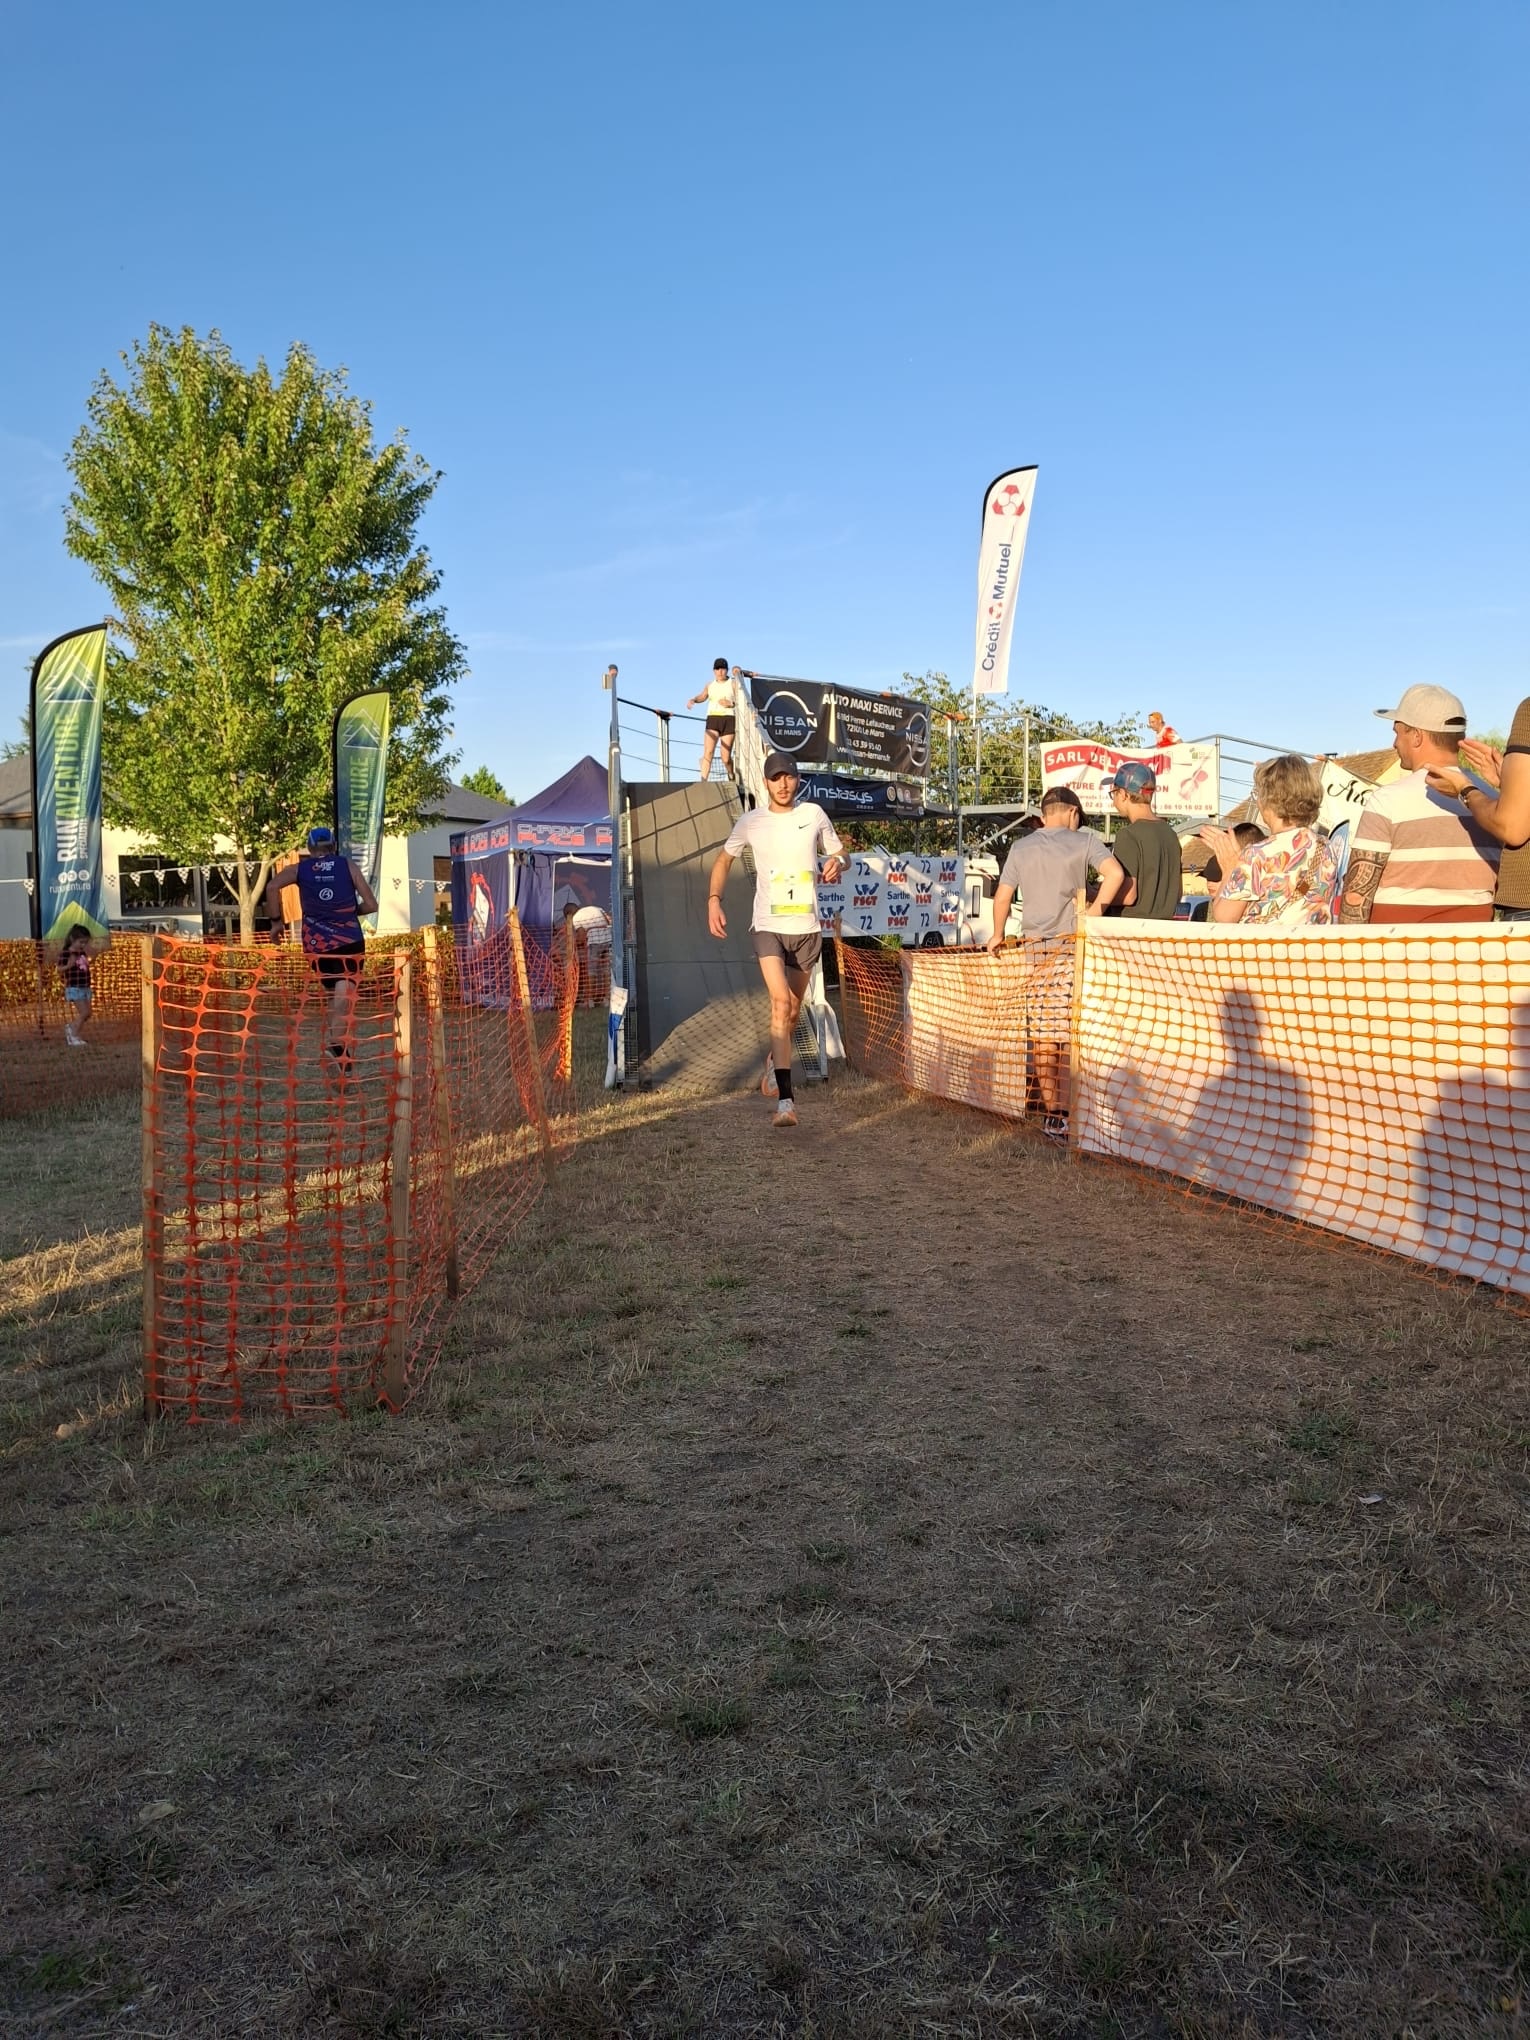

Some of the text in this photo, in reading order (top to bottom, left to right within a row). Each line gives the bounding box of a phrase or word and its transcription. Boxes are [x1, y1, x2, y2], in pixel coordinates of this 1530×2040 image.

[981, 543, 1012, 670] Crédit Mutuel
[822, 693, 903, 718] AUTO MAXI SERVICE
[759, 715, 818, 728] NISSAN
[905, 732, 929, 745] NISSA
[1046, 751, 1086, 766] SARL
[55, 712, 80, 862] RUNAVENTURE
[813, 785, 873, 804] Instasys
[517, 823, 585, 835] CHRONO
[517, 831, 586, 847] PLACE
[855, 862, 871, 876] 72
[921, 860, 931, 874] 72
[787, 888, 794, 901] 1
[817, 892, 846, 902] Sarthe
[853, 895, 878, 907] FSGT
[887, 890, 911, 900] Sarthe
[860, 916, 873, 930] 72
[887, 917, 909, 927] FSGT
[920, 912, 930, 927] 72
